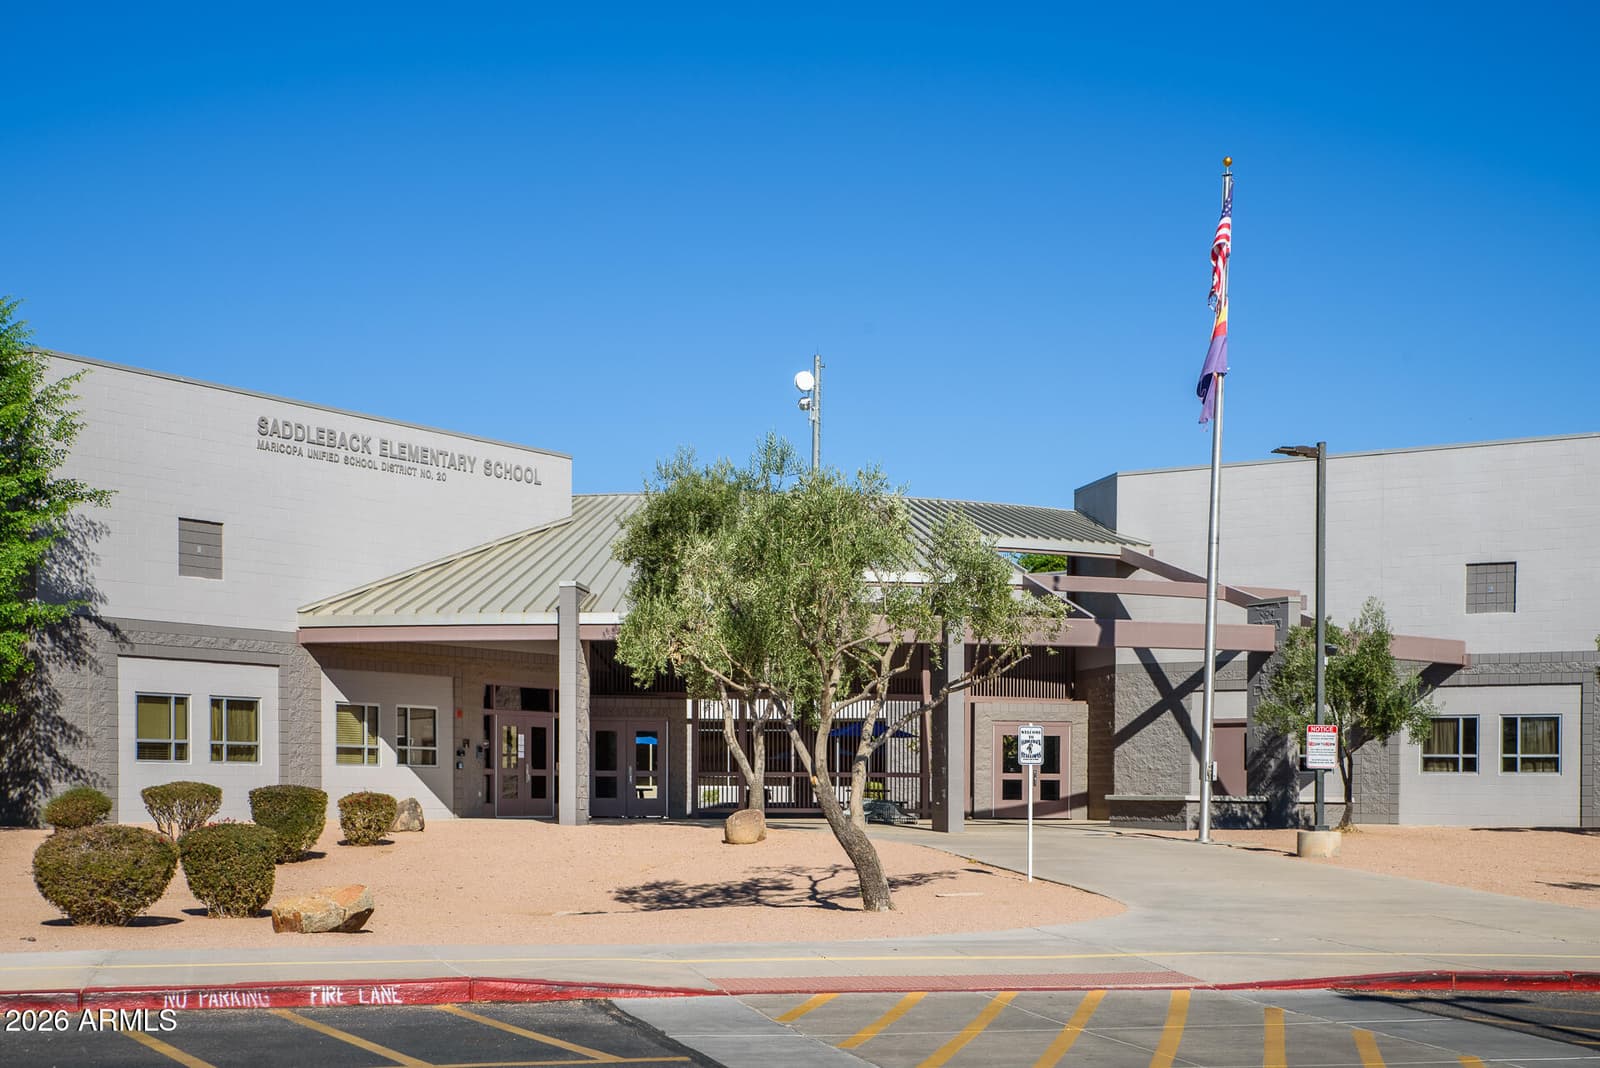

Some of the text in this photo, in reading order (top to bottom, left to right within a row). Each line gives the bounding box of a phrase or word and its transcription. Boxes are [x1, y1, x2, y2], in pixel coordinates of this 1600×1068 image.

[256, 439, 448, 483] MARICOPA UNIFIED SCHOOL DISTRICT NO. 20
[257, 416, 542, 486] SADDLEBACK ELEMENTARY SCHOOL
[163, 985, 403, 1008] NO PARKING FIRE LANE
